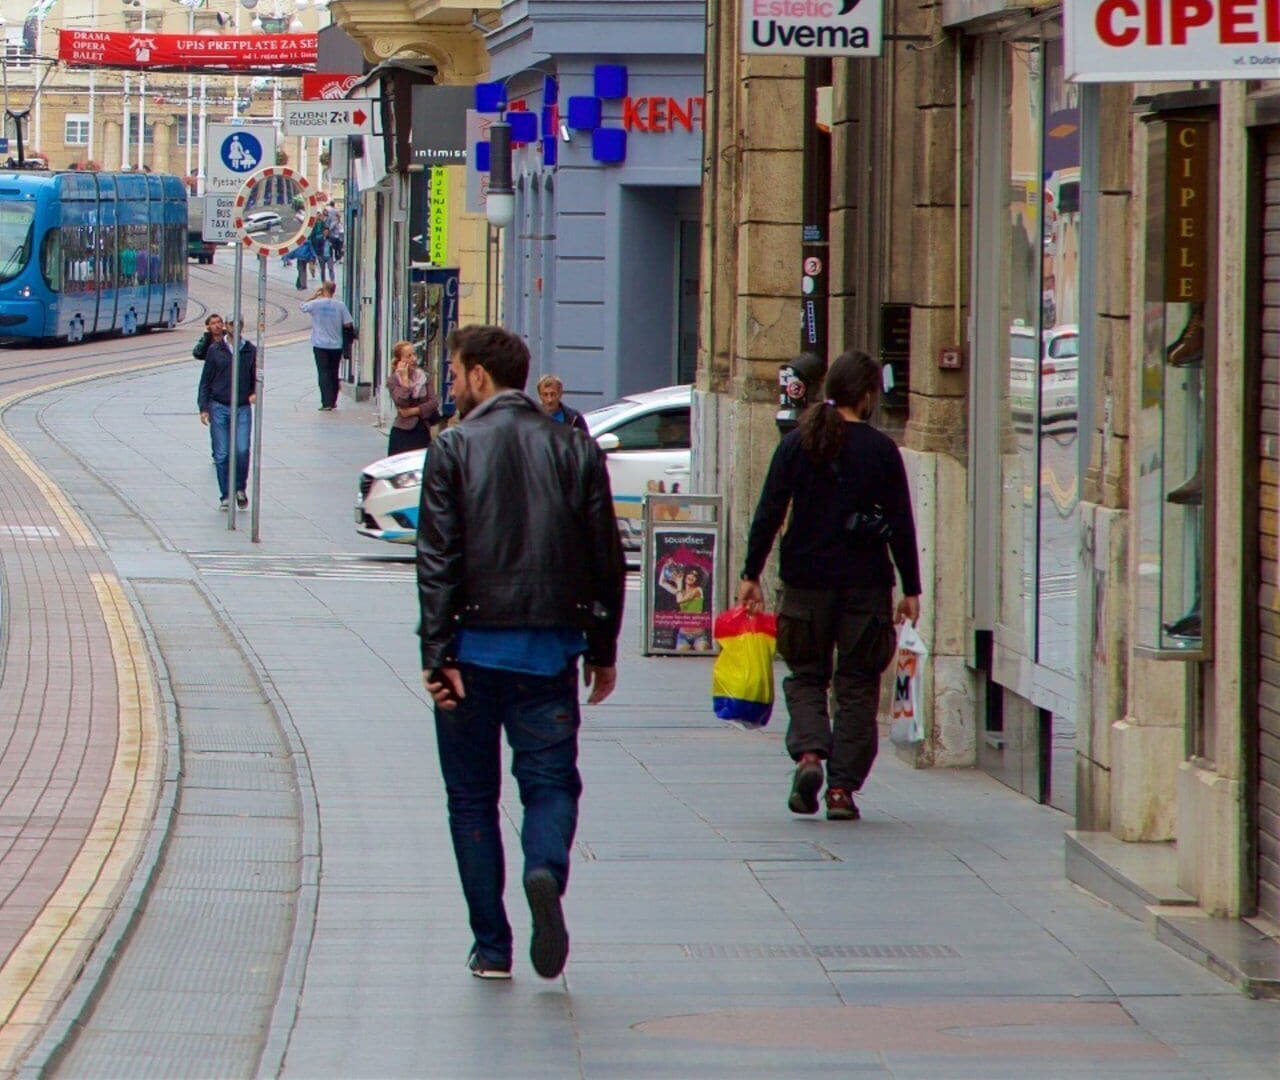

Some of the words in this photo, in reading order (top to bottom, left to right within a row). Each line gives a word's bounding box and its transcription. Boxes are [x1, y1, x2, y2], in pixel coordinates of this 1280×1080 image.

[73, 32, 111, 41] DRAMA
[73, 41, 106, 51] OPERA
[177, 39, 204, 50] UPIS
[207, 39, 278, 50] PRETPLATE
[280, 39, 297, 49] ZA
[73, 51, 104, 61] BALET
[1178, 127, 1198, 298] CIPELE
